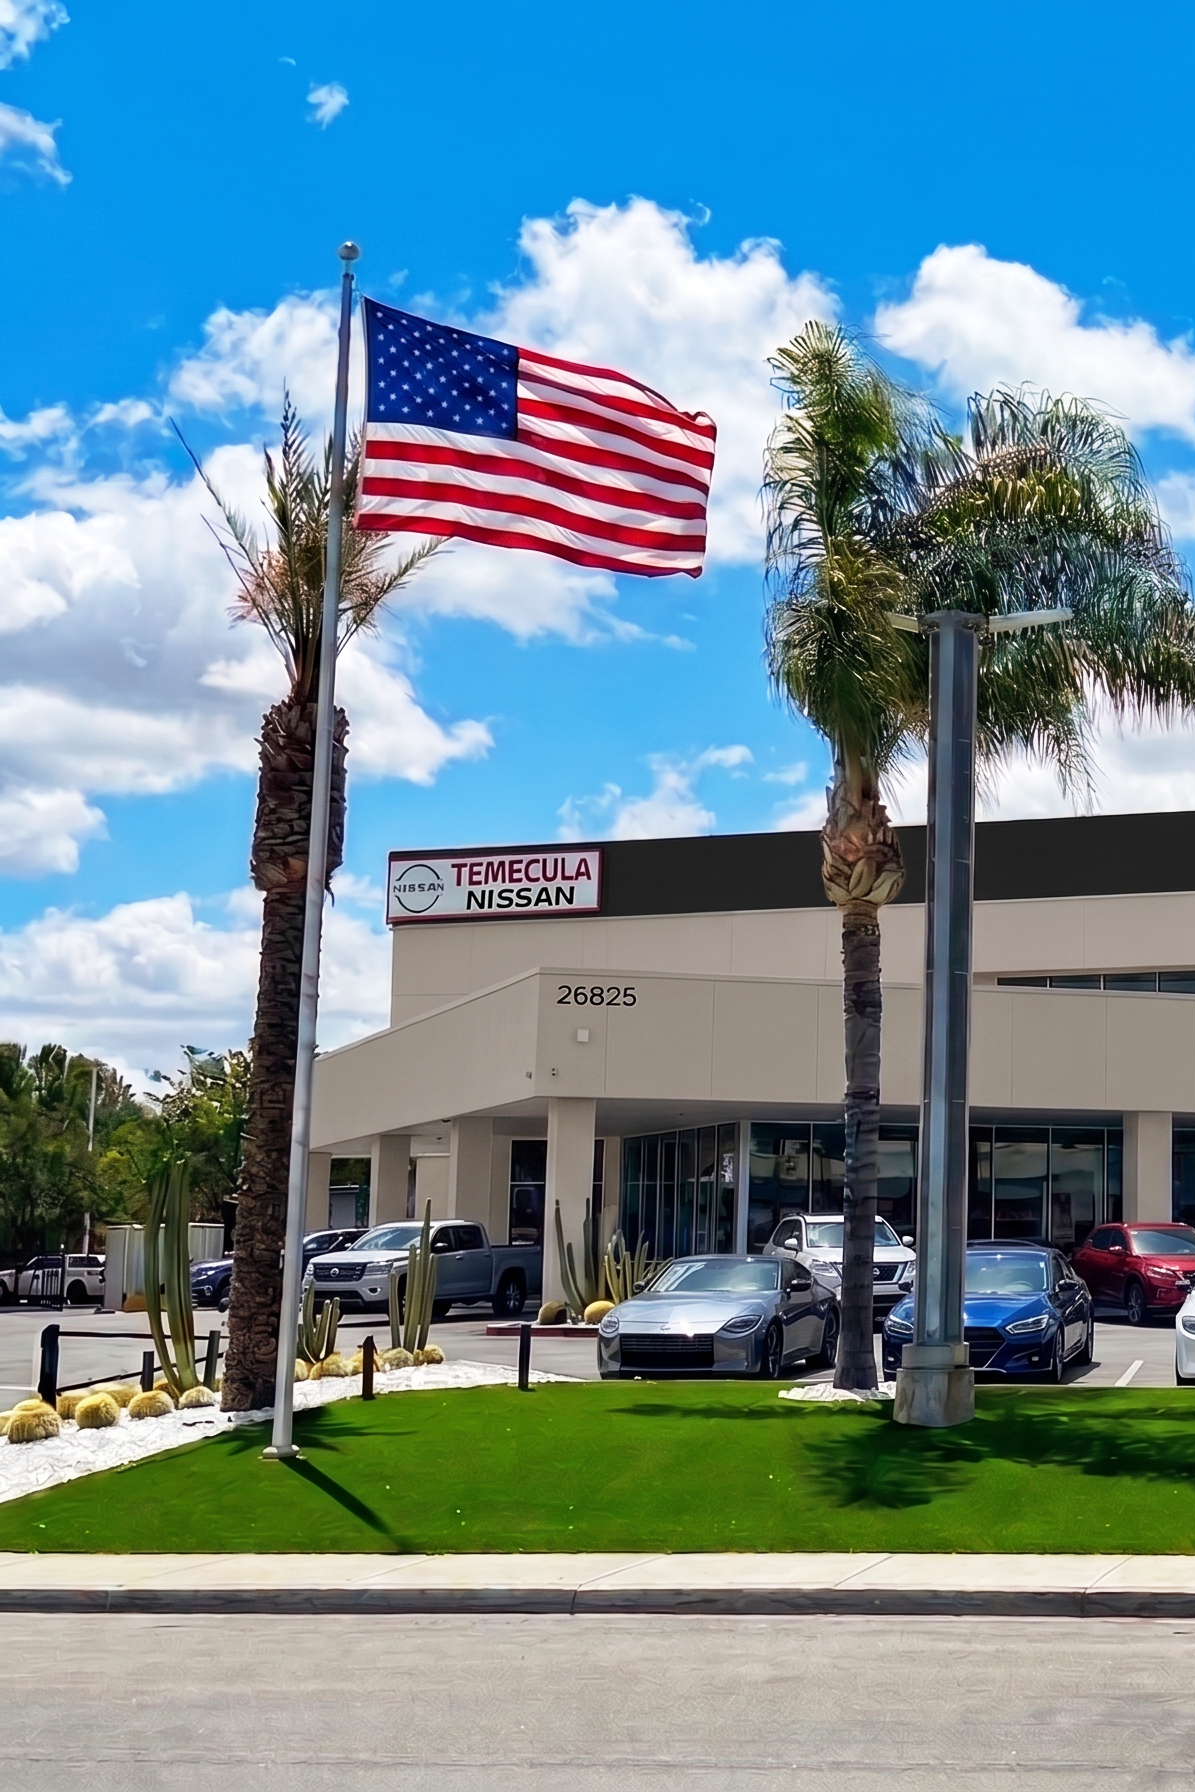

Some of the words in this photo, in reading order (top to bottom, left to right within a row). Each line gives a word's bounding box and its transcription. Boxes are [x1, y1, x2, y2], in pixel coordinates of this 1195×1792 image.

[451, 858, 591, 886] TEMECULA
[393, 883, 444, 893] NISSAN
[466, 886, 575, 910] NISSAN
[556, 985, 637, 1006] 26825
